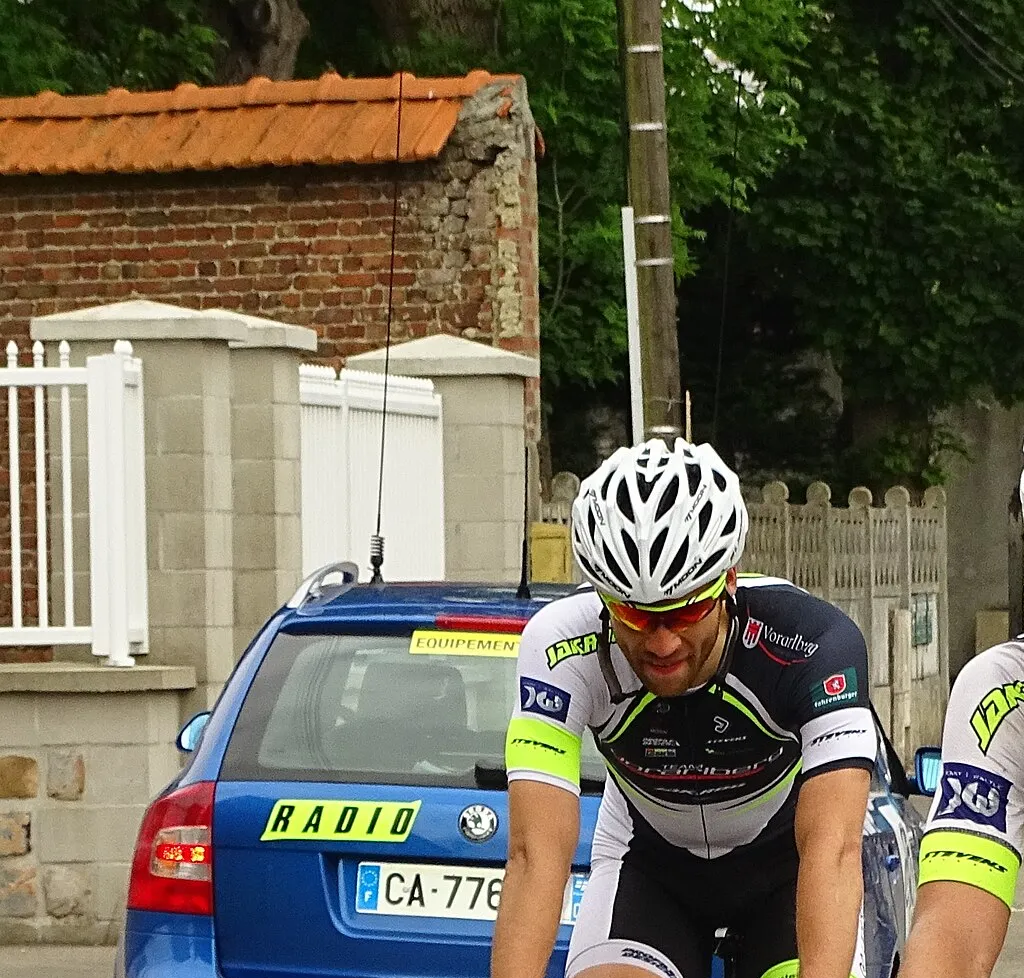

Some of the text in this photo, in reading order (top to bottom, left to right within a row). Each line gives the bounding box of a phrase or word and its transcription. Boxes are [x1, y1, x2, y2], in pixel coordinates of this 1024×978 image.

[600, 572, 631, 599] MOON
[674, 558, 703, 589] MOON
[416, 638, 520, 651] EQUIPEMEN
[271, 806, 414, 836] RADIO
[921, 851, 1008, 874] STEVENS
